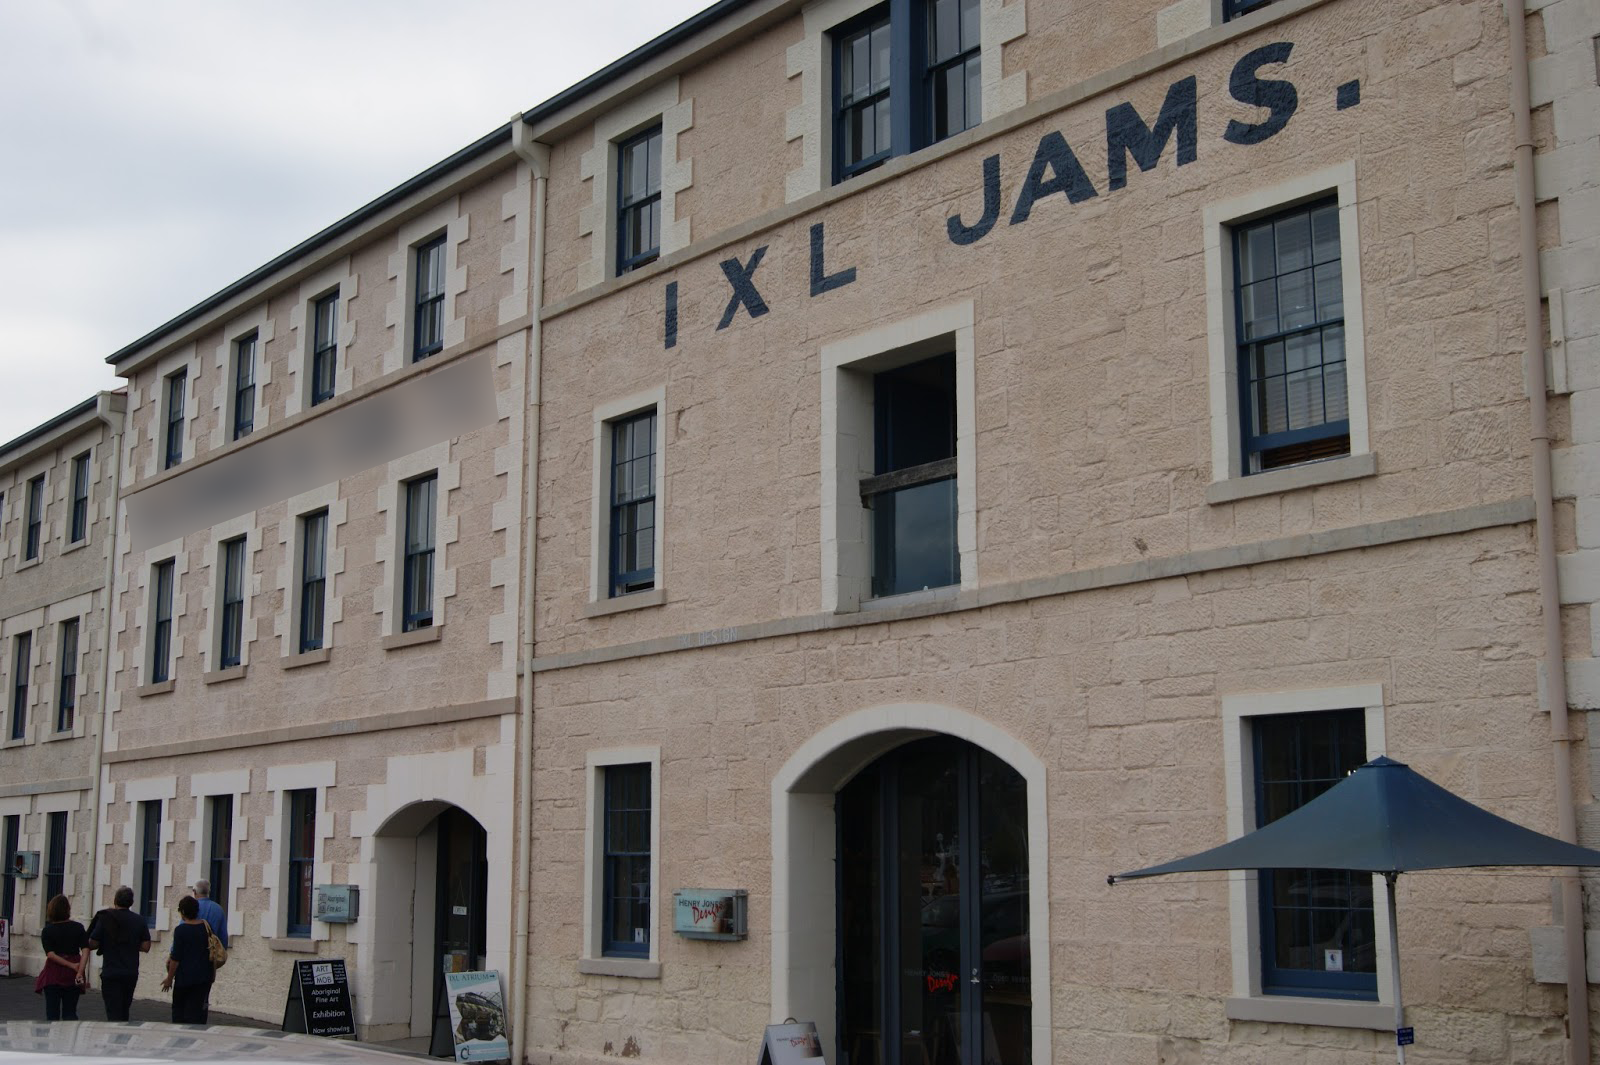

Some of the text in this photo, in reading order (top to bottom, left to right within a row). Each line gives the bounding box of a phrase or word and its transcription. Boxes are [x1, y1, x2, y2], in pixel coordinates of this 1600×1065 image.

[664, 222, 857, 349] IXL
[699, 627, 737, 645] DESIGN
[679, 898, 701, 908] HENRY
[316, 965, 329, 973] ART
[316, 976, 332, 984] MOB
[462, 973, 490, 982] ATRIUM
[311, 988, 340, 996] Aboriginal
[312, 1010, 346, 1019] Exhibition
